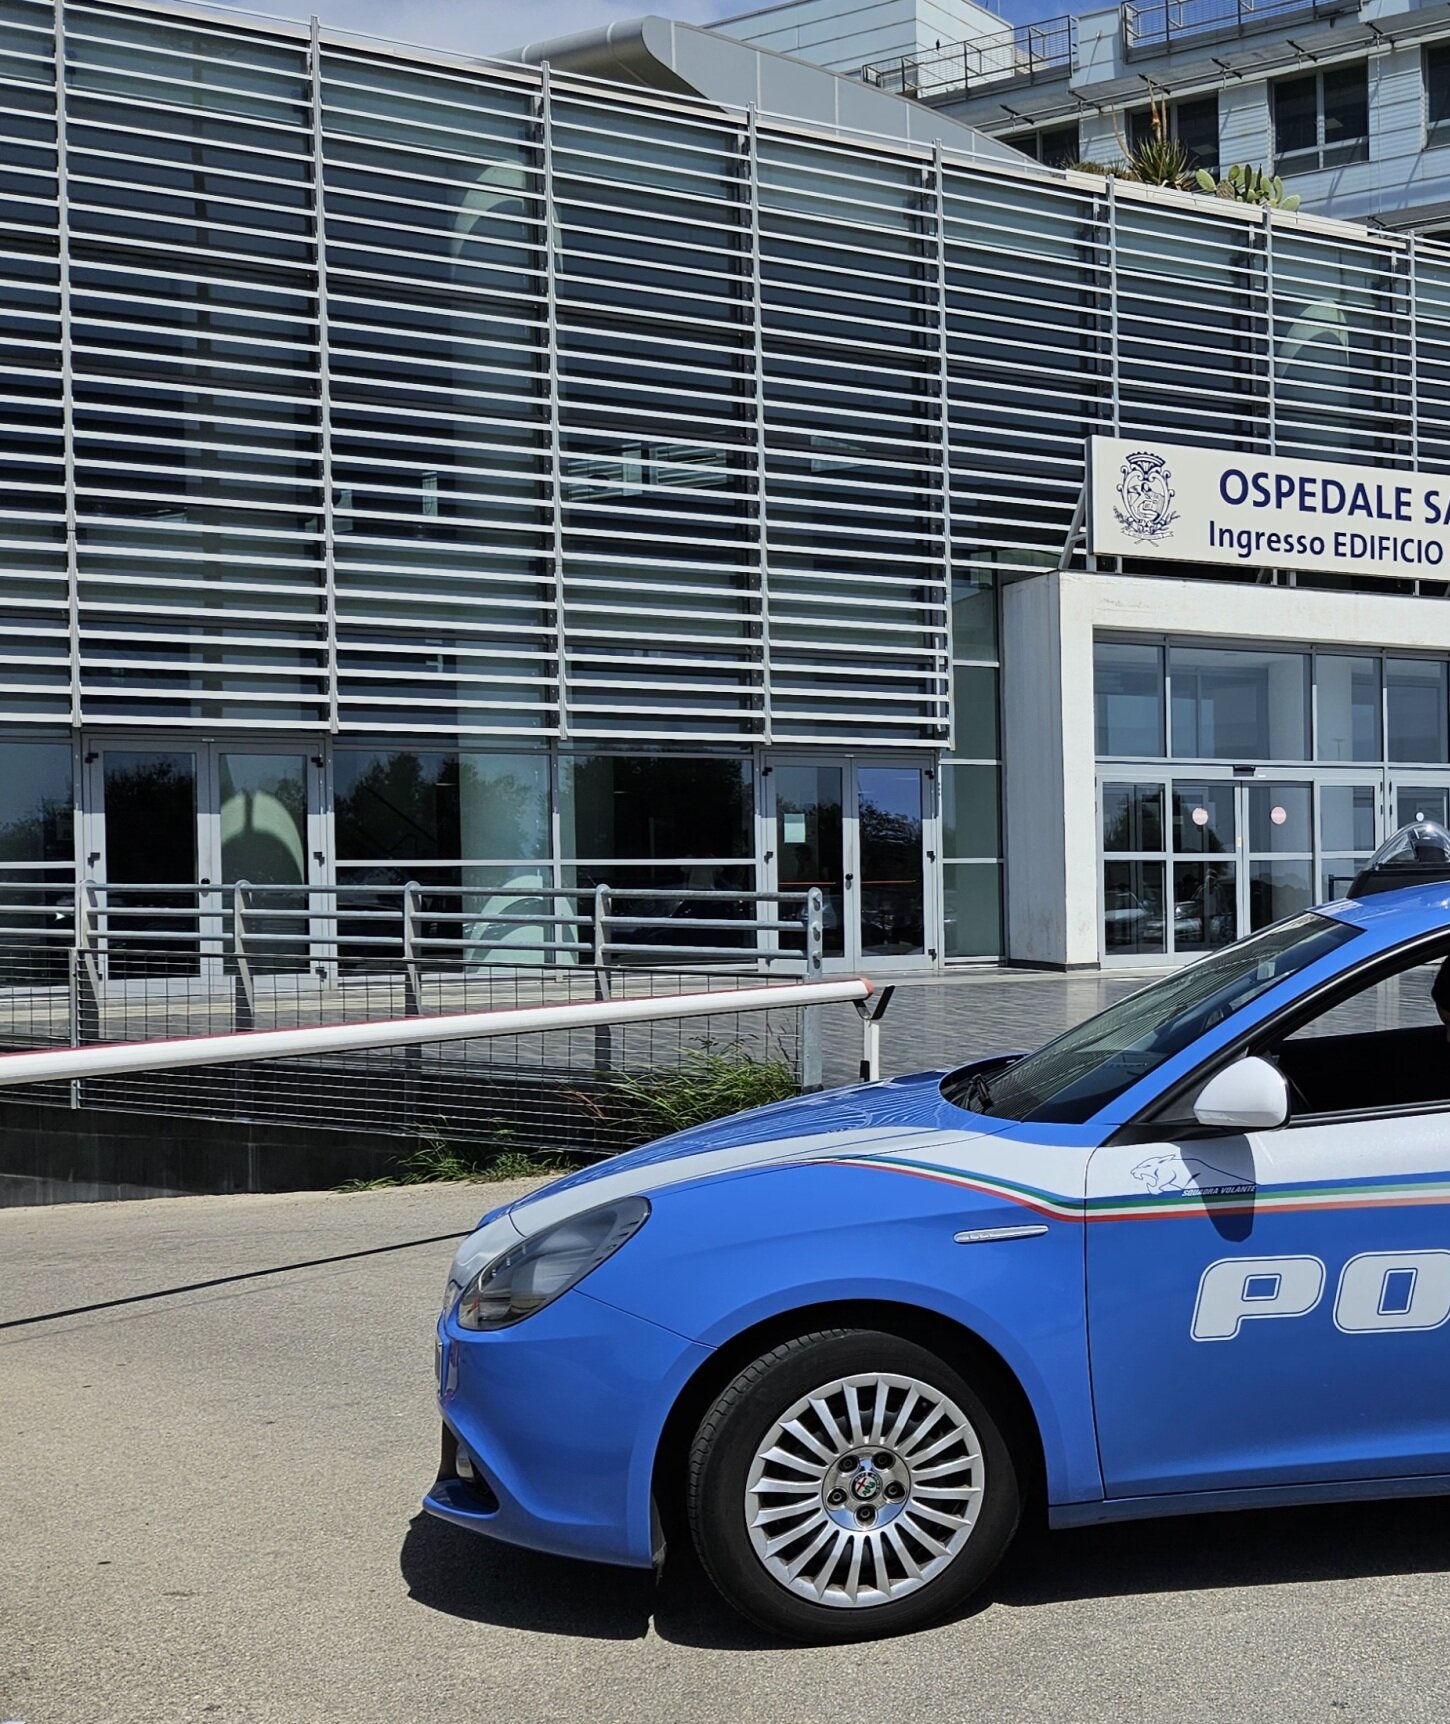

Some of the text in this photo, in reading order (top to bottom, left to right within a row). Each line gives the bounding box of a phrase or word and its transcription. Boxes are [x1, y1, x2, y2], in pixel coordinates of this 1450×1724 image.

[1219, 468, 1412, 522] OSPEDALE
[1209, 520, 1325, 558] Ingresso
[1334, 532, 1443, 565] EDIFICIO
[1181, 1185, 1257, 1197] SQUADRA VOLANTE
